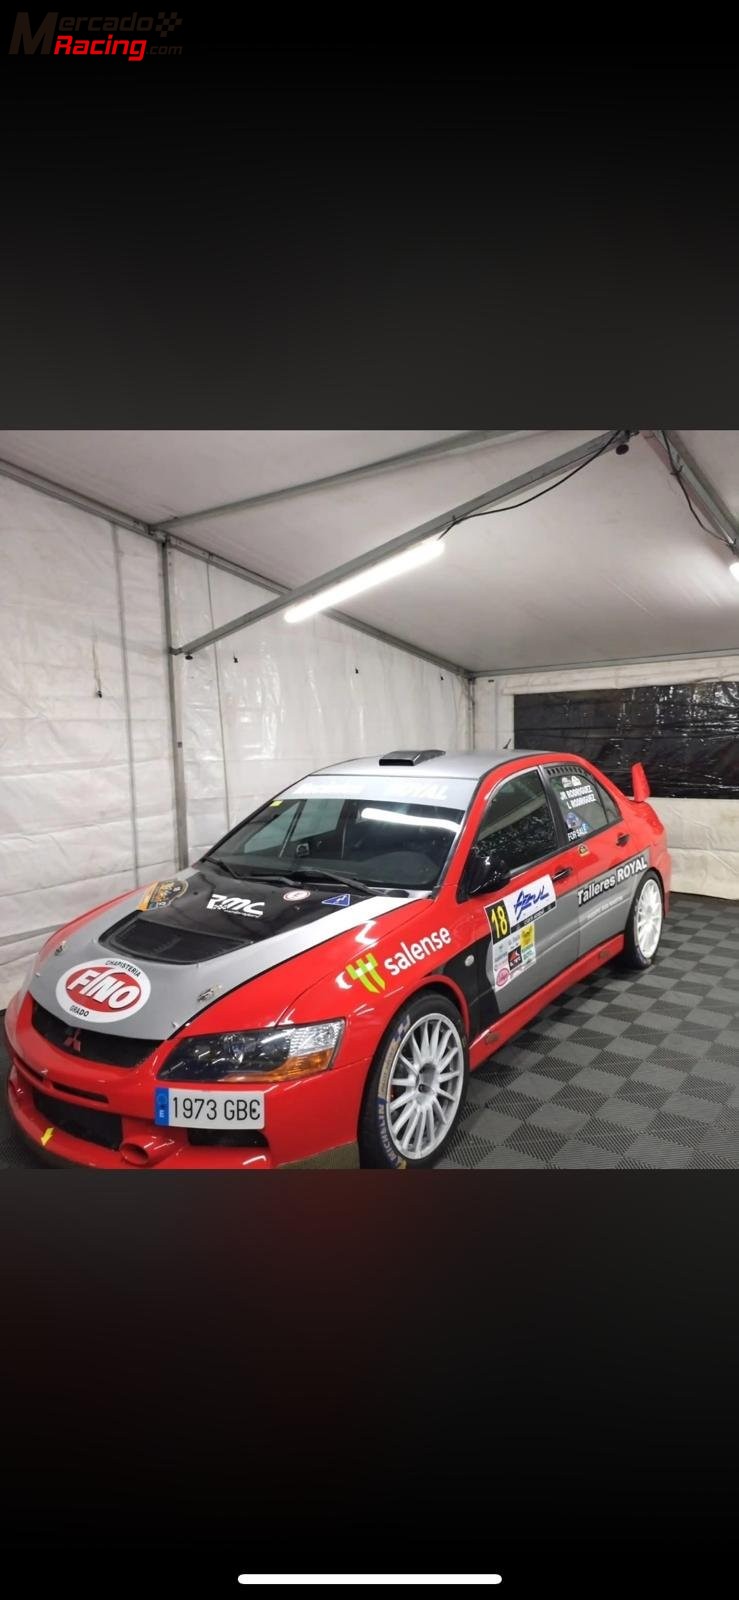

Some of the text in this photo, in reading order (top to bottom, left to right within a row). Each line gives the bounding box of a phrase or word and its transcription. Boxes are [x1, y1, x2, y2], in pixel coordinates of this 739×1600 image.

[577, 856, 648, 905] Talleres ROYAL
[491, 905, 508, 939] 18
[384, 927, 452, 975] salense
[66, 968, 140, 1009] FINO
[69, 1005, 90, 1017] GRADO
[173, 1097, 260, 1121] 1973 GBC
